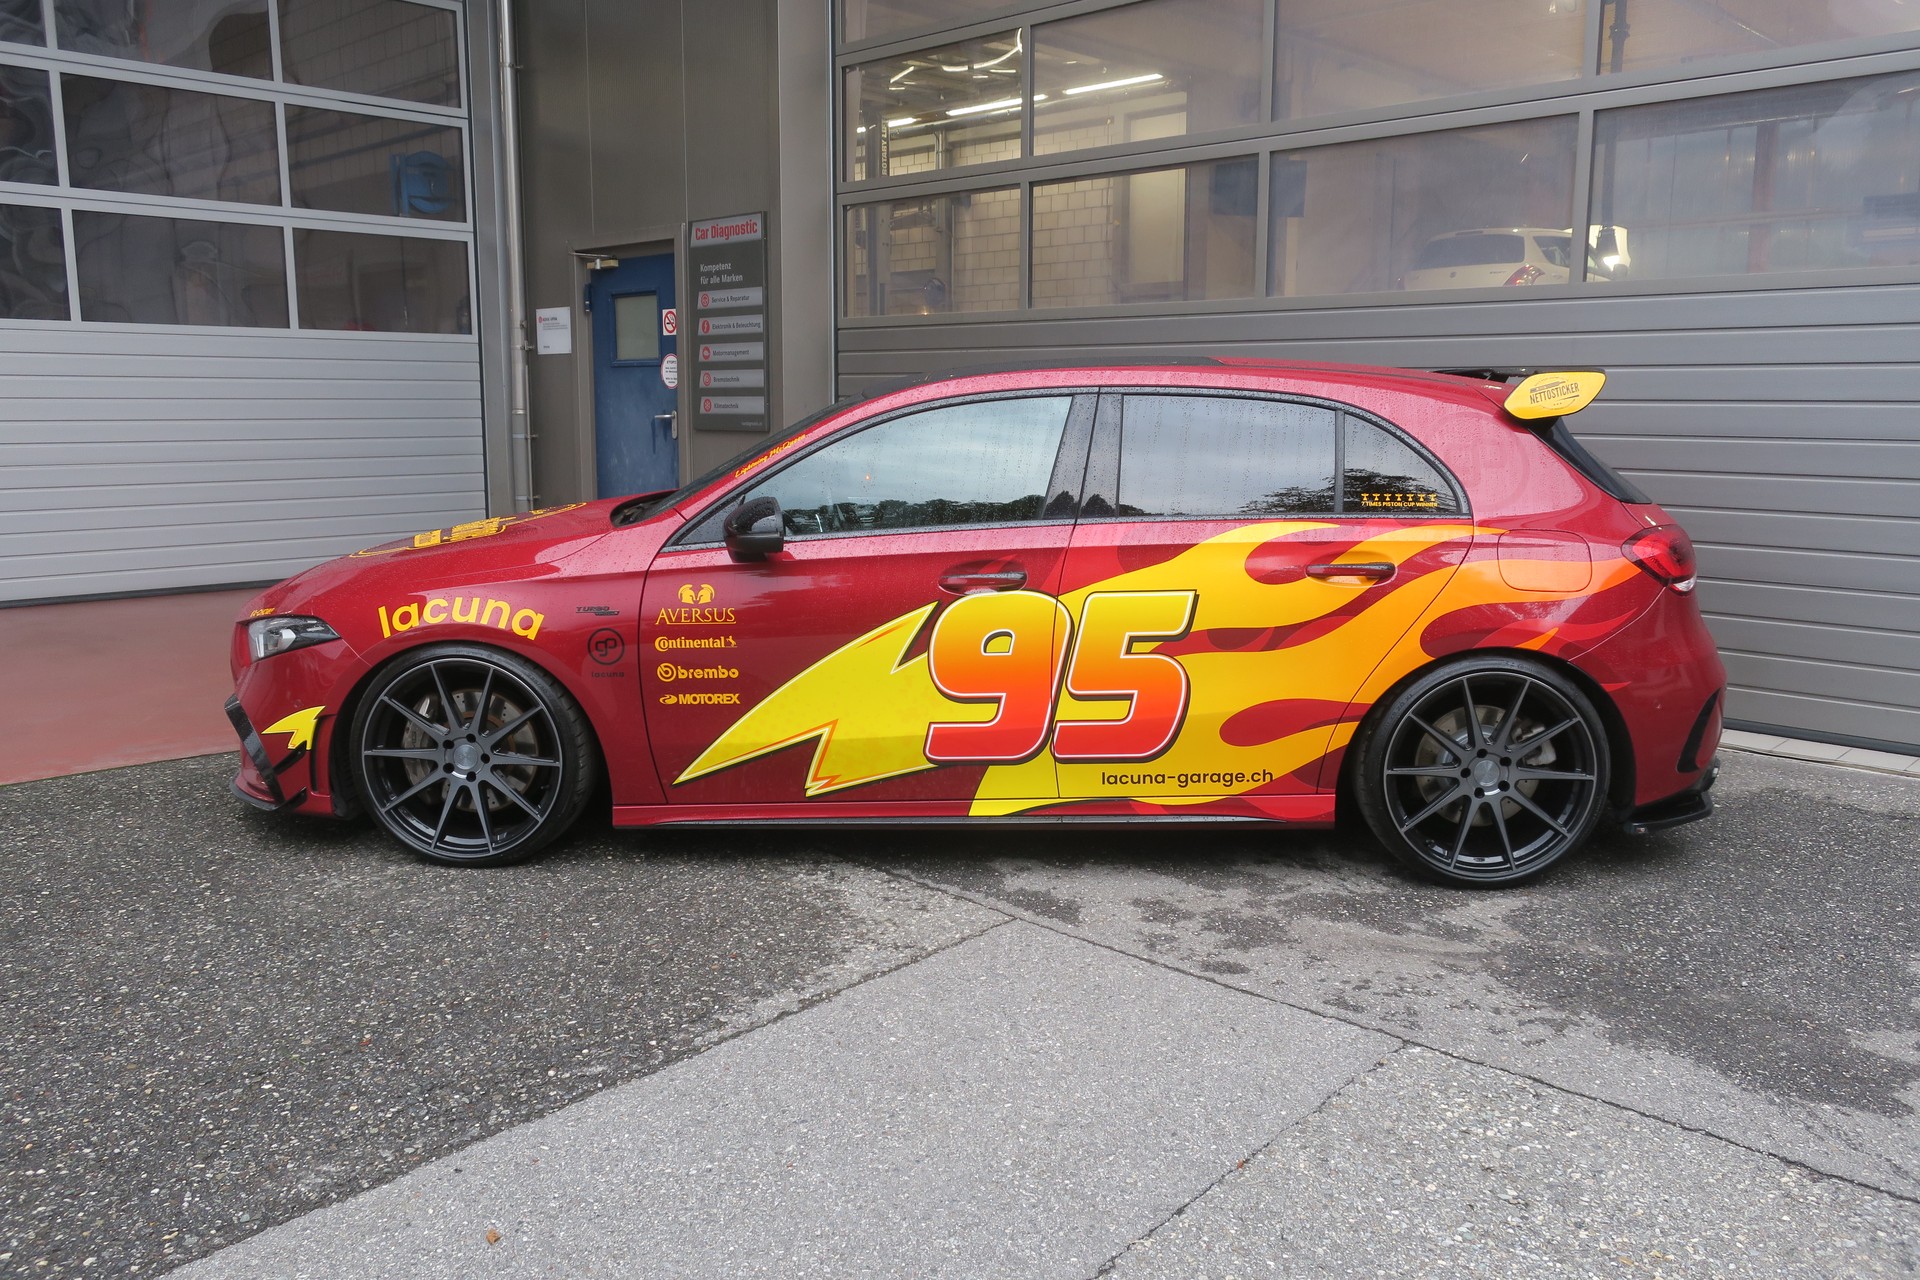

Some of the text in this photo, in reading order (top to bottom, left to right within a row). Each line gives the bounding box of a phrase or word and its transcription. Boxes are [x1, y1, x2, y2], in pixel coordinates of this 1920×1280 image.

[695, 219, 758, 240] Car Diagnostic
[700, 263, 732, 273] Kompetenz
[700, 273, 744, 285] für alle Marken
[711, 322, 732, 330] Elektronik
[736, 321, 761, 329] Beleuchtung
[1530, 382, 1580, 404] NETTOSTICKER
[377, 597, 544, 640] lacuna
[655, 607, 737, 625] AVERSUS
[655, 636, 725, 652] Continental
[677, 665, 739, 679] brembo
[924, 589, 1199, 765] 95
[679, 693, 741, 705] MOTOREX
[1101, 769, 1274, 788] lacuna-garage.ch
